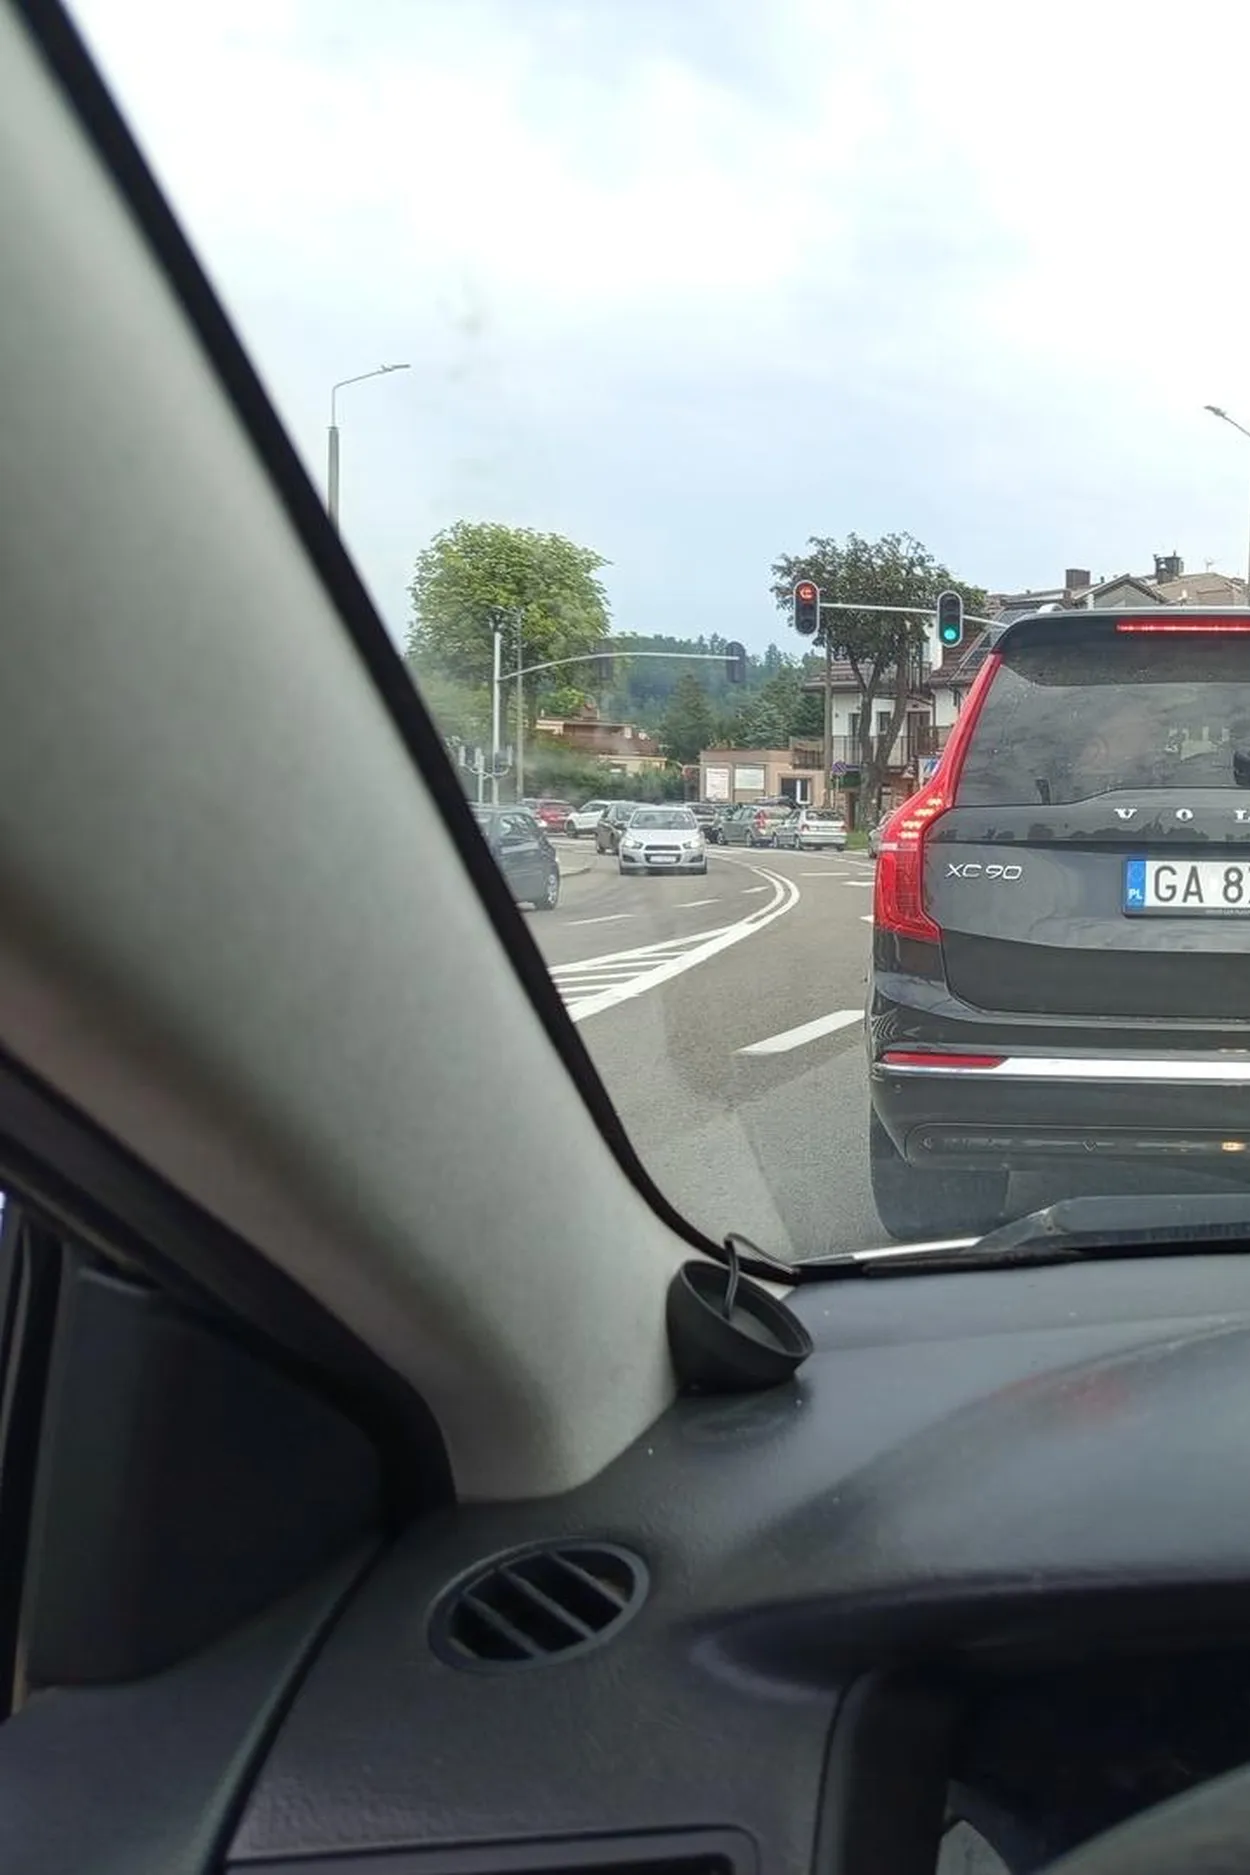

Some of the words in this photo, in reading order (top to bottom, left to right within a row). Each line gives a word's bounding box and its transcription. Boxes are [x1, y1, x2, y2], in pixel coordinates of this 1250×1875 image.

[945, 863, 1022, 880] XC90
[1153, 865, 1204, 903] GA
[1127, 888, 1143, 901] PL
